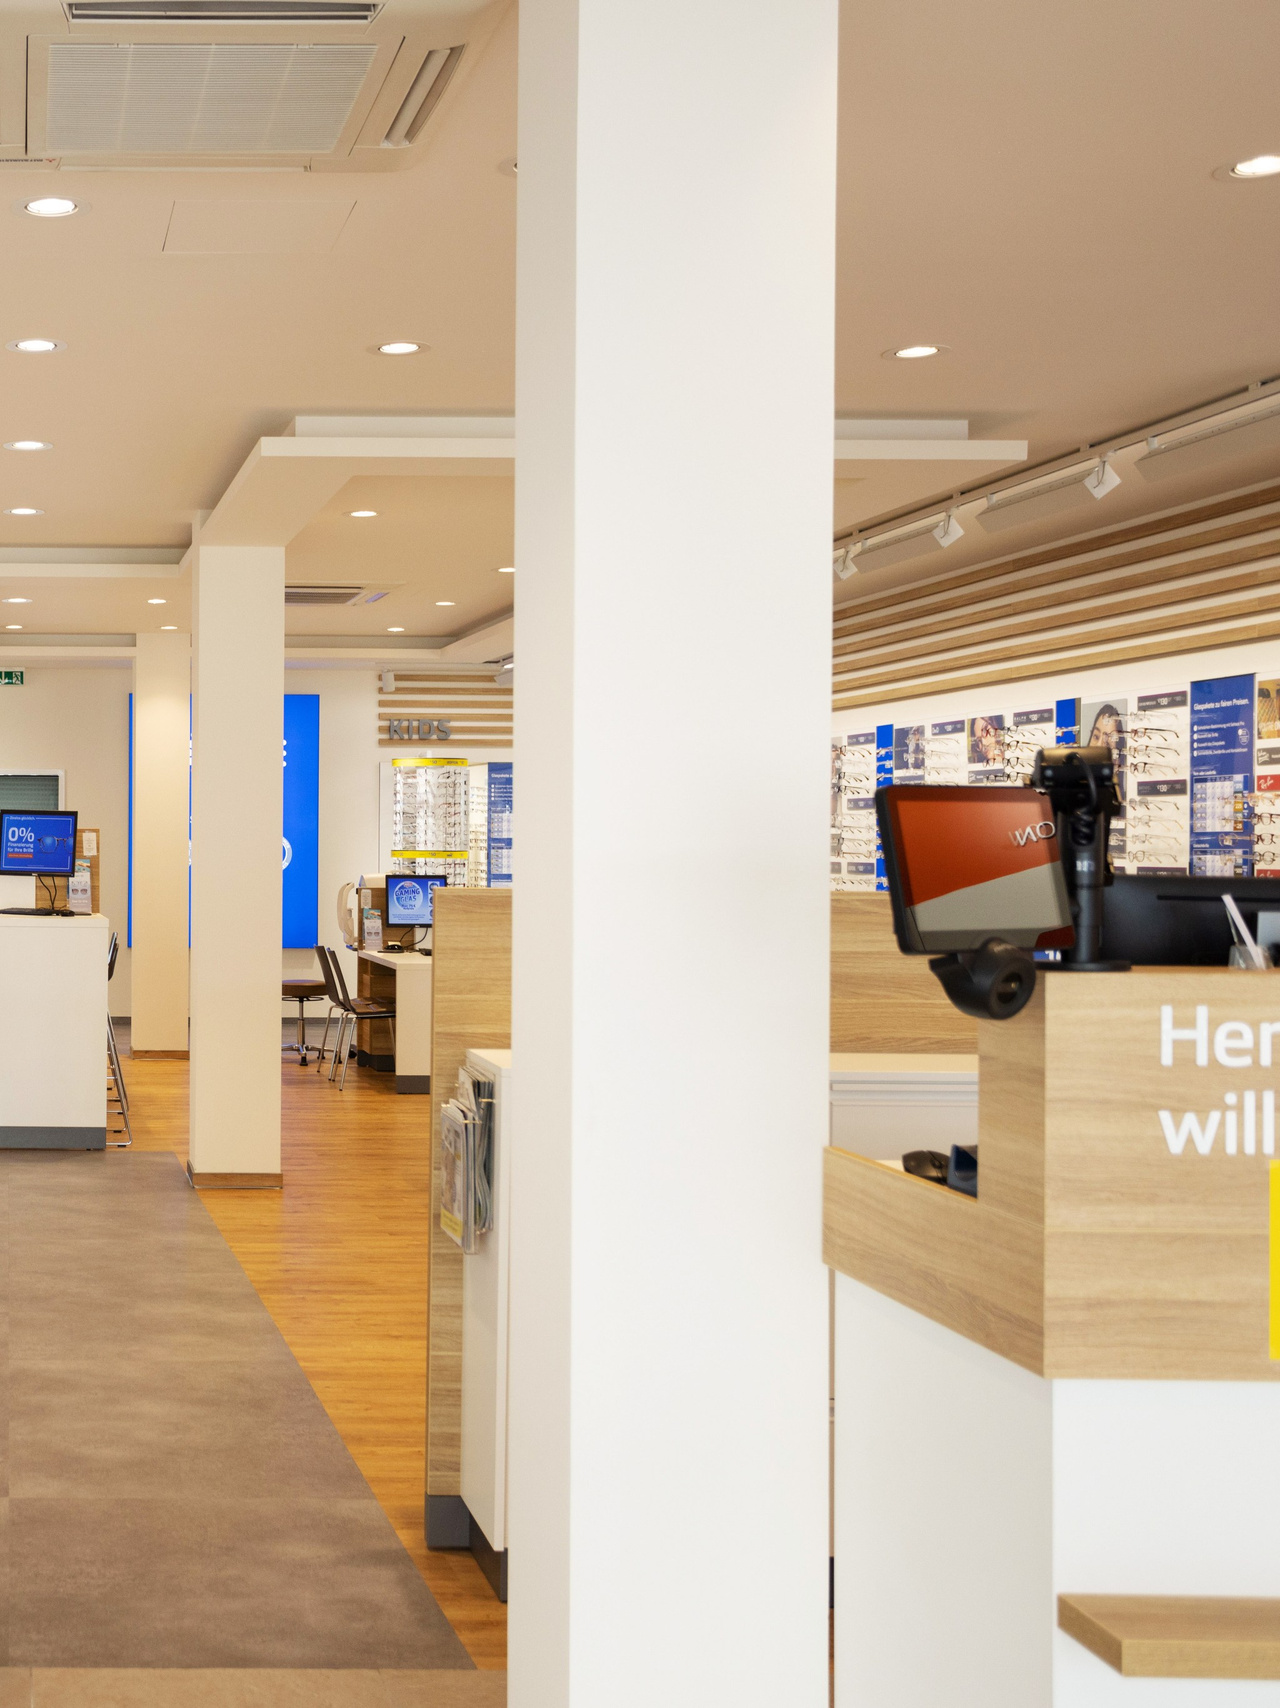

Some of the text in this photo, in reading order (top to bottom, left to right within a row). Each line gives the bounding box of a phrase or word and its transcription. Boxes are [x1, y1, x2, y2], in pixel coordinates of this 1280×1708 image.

[389, 719, 452, 741] KIDS
[8, 827, 35, 842] 0%
[395, 888, 421, 897] GAMING
[1158, 1089, 1275, 1156] will
